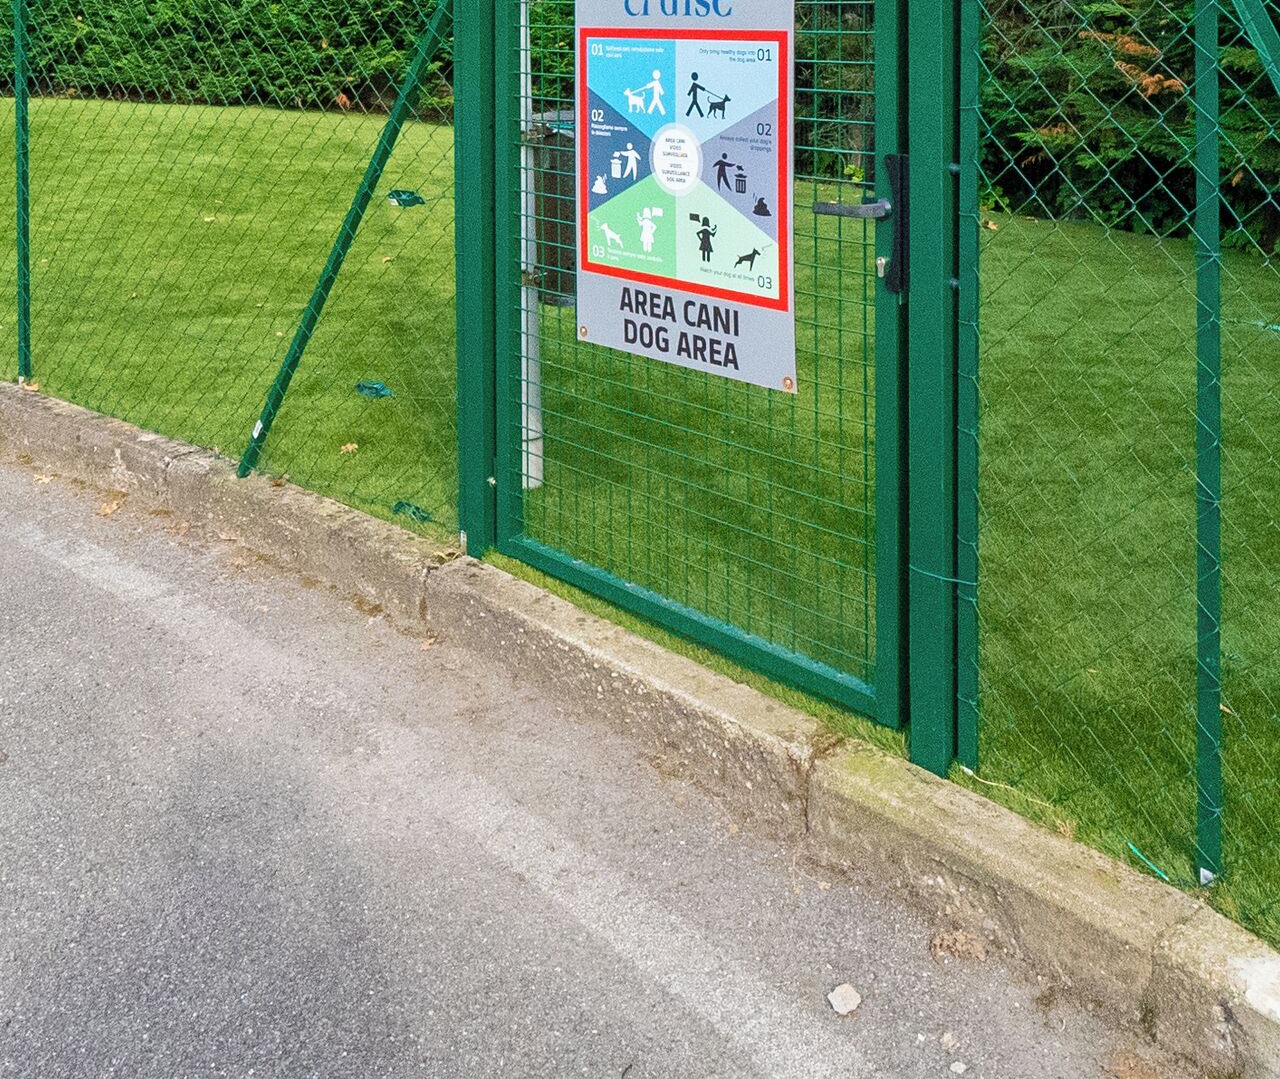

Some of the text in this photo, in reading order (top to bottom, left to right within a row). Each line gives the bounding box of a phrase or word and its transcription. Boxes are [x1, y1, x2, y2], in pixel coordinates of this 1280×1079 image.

[591, 43, 604, 56] 01
[757, 48, 772, 61] 01
[591, 109, 604, 122] 02
[756, 122, 772, 136] 02
[592, 244, 605, 258] 03
[757, 274, 772, 289] 03
[620, 286, 740, 337] AREA CANI
[624, 318, 740, 371] DOG AREA
